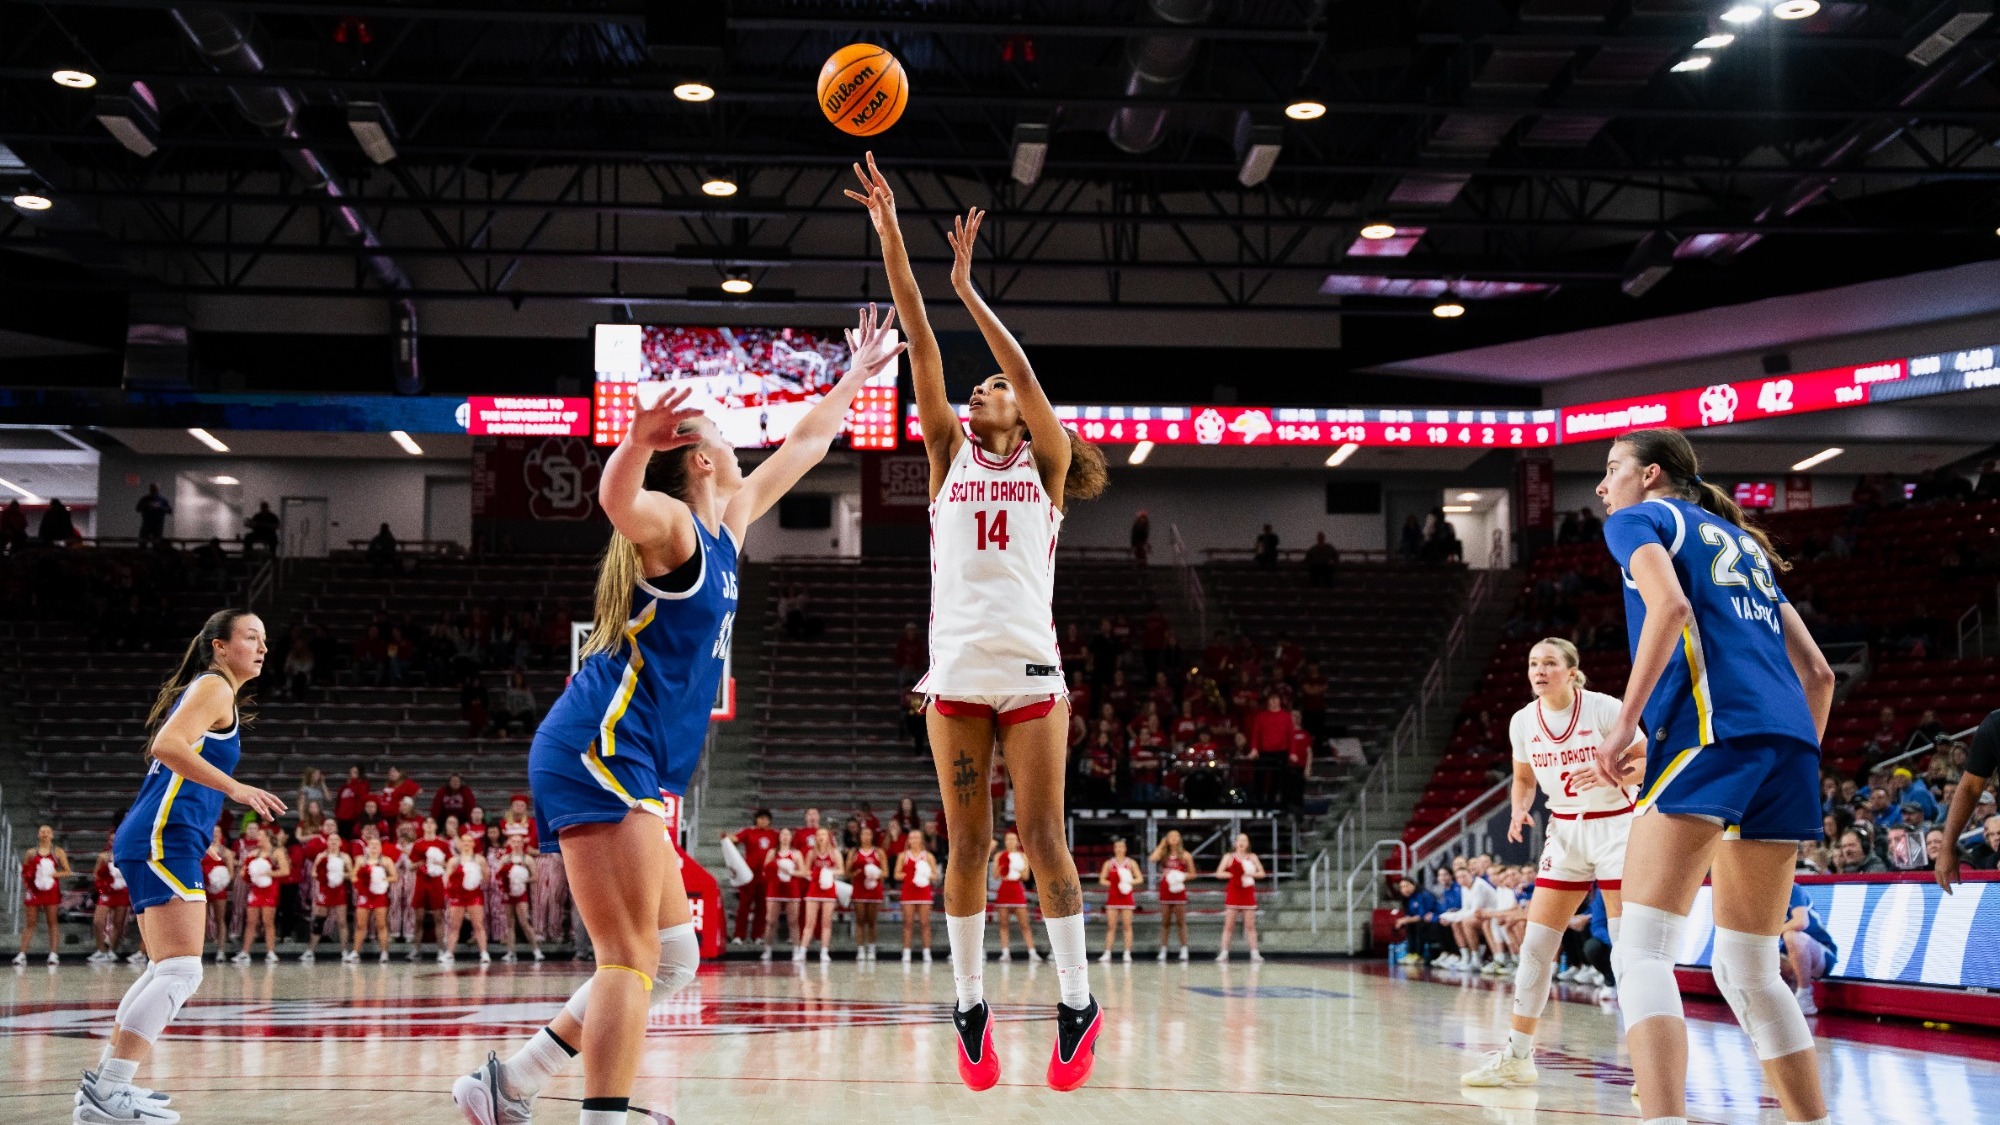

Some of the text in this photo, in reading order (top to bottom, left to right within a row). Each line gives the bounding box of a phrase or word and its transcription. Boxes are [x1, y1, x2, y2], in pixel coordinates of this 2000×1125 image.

[826, 66, 875, 114] Wilson
[851, 90, 888, 127] NCAA
[549, 398, 564, 410] TO
[1757, 379, 1794, 413] 42
[1110, 422, 1123, 439] 4
[1135, 422, 1148, 440] 2
[1276, 425, 1320, 441] 15-34
[1330, 426, 1366, 441] 3-13
[1458, 427, 1471, 443] 4
[1481, 427, 1495, 444] 2
[1510, 428, 1523, 444] 2
[949, 481, 1040, 503] SOUTH DAKOTA
[975, 509, 1010, 550] 14
[1698, 522, 1779, 601] 23
[1532, 752, 1559, 768] SOUTH
